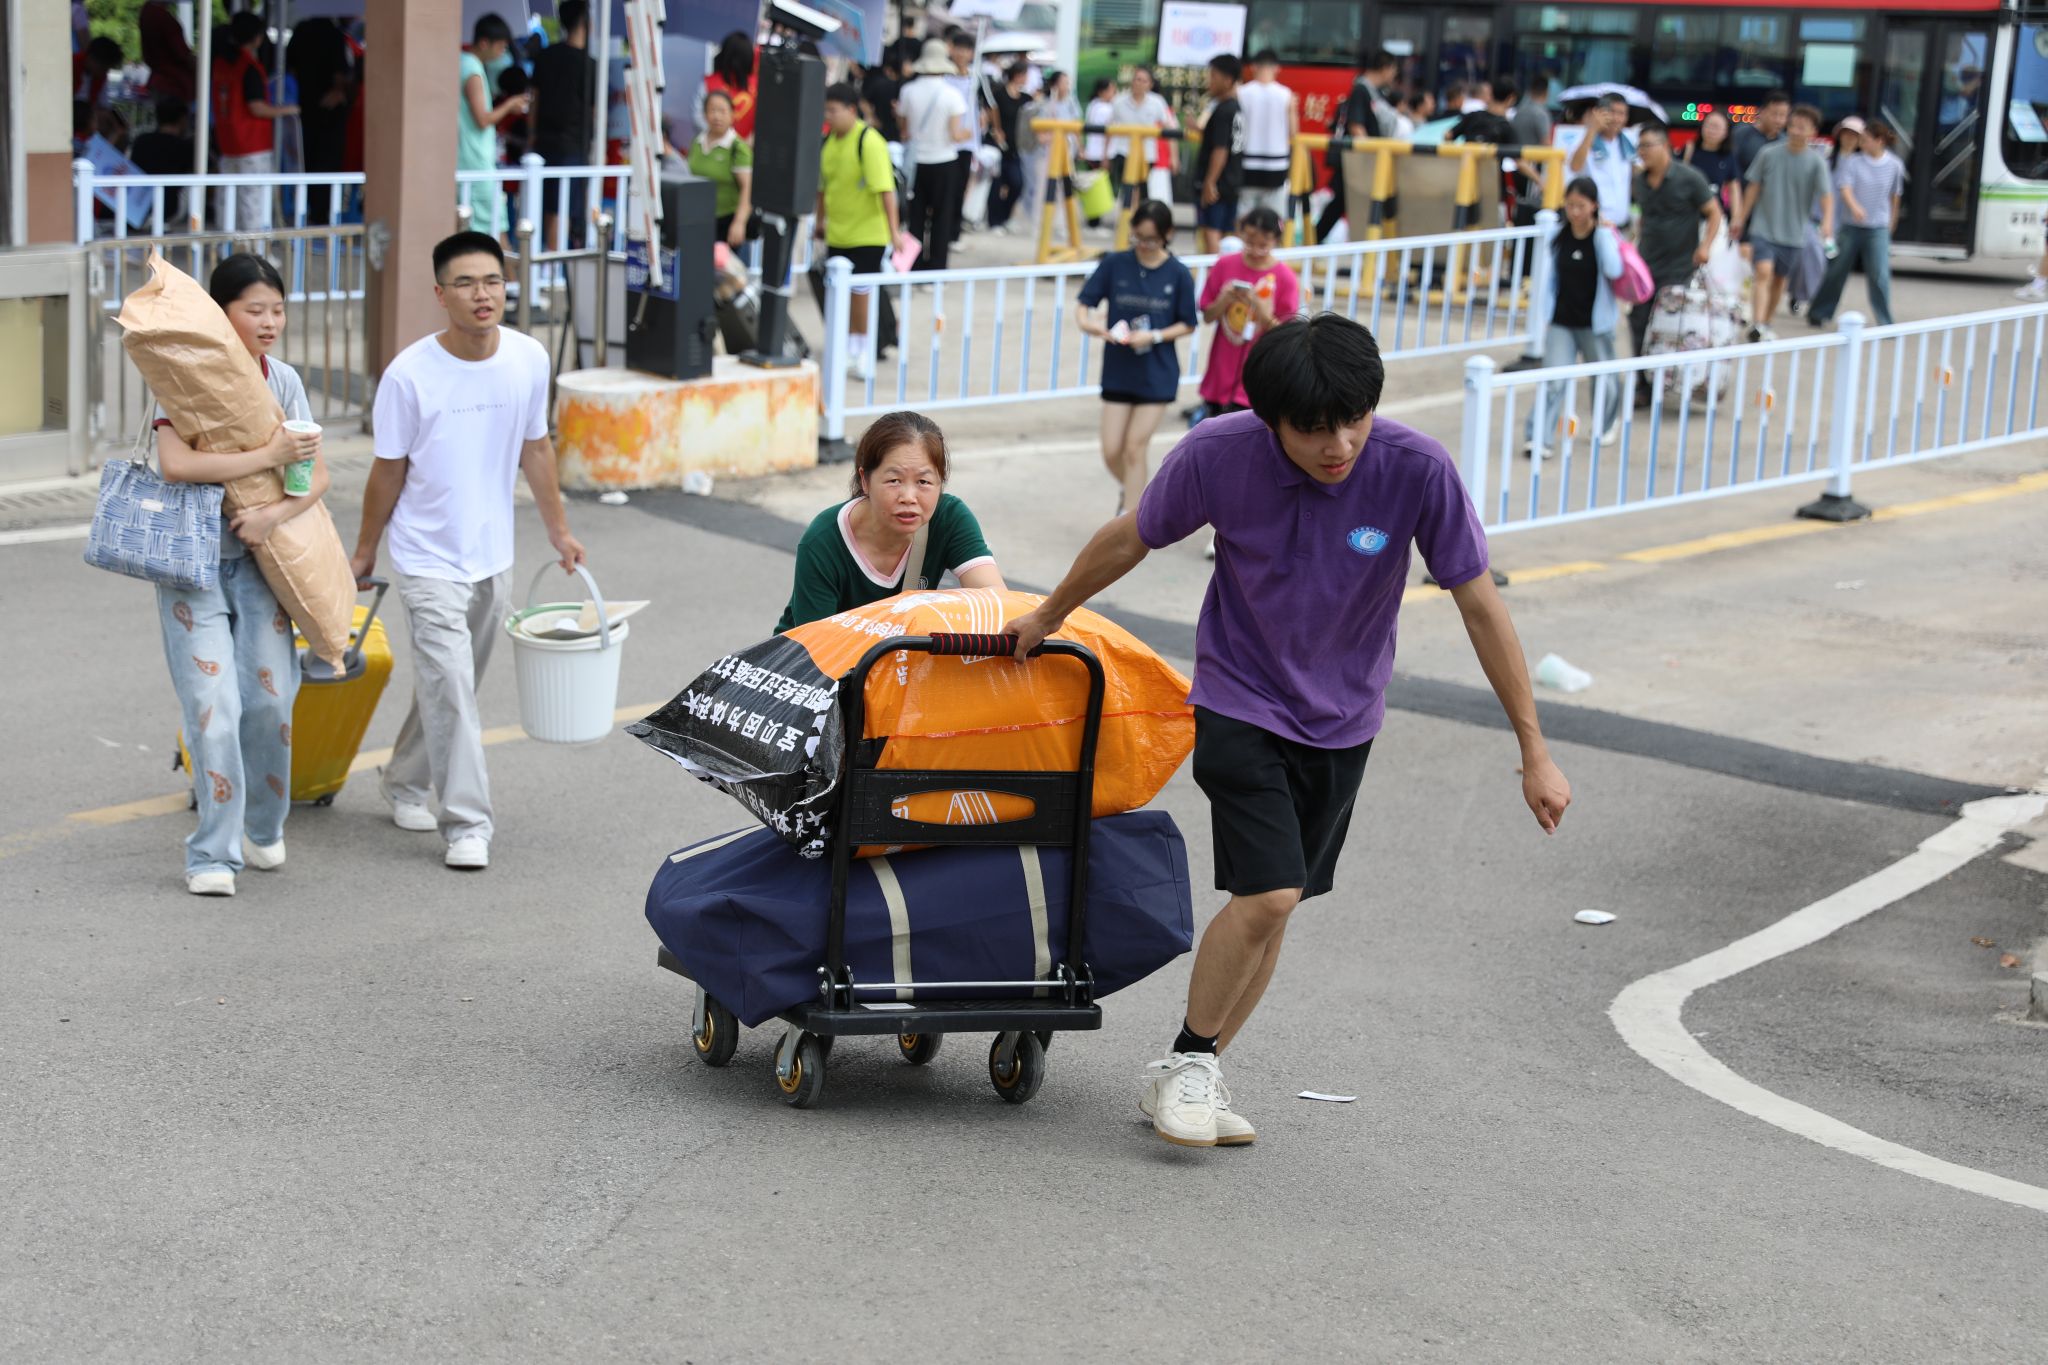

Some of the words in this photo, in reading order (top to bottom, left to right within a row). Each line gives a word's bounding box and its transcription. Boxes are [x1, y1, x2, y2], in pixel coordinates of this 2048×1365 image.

[705, 655, 831, 713] 都是经过压缩打
[682, 689, 804, 752] 宝贝因为体积大
